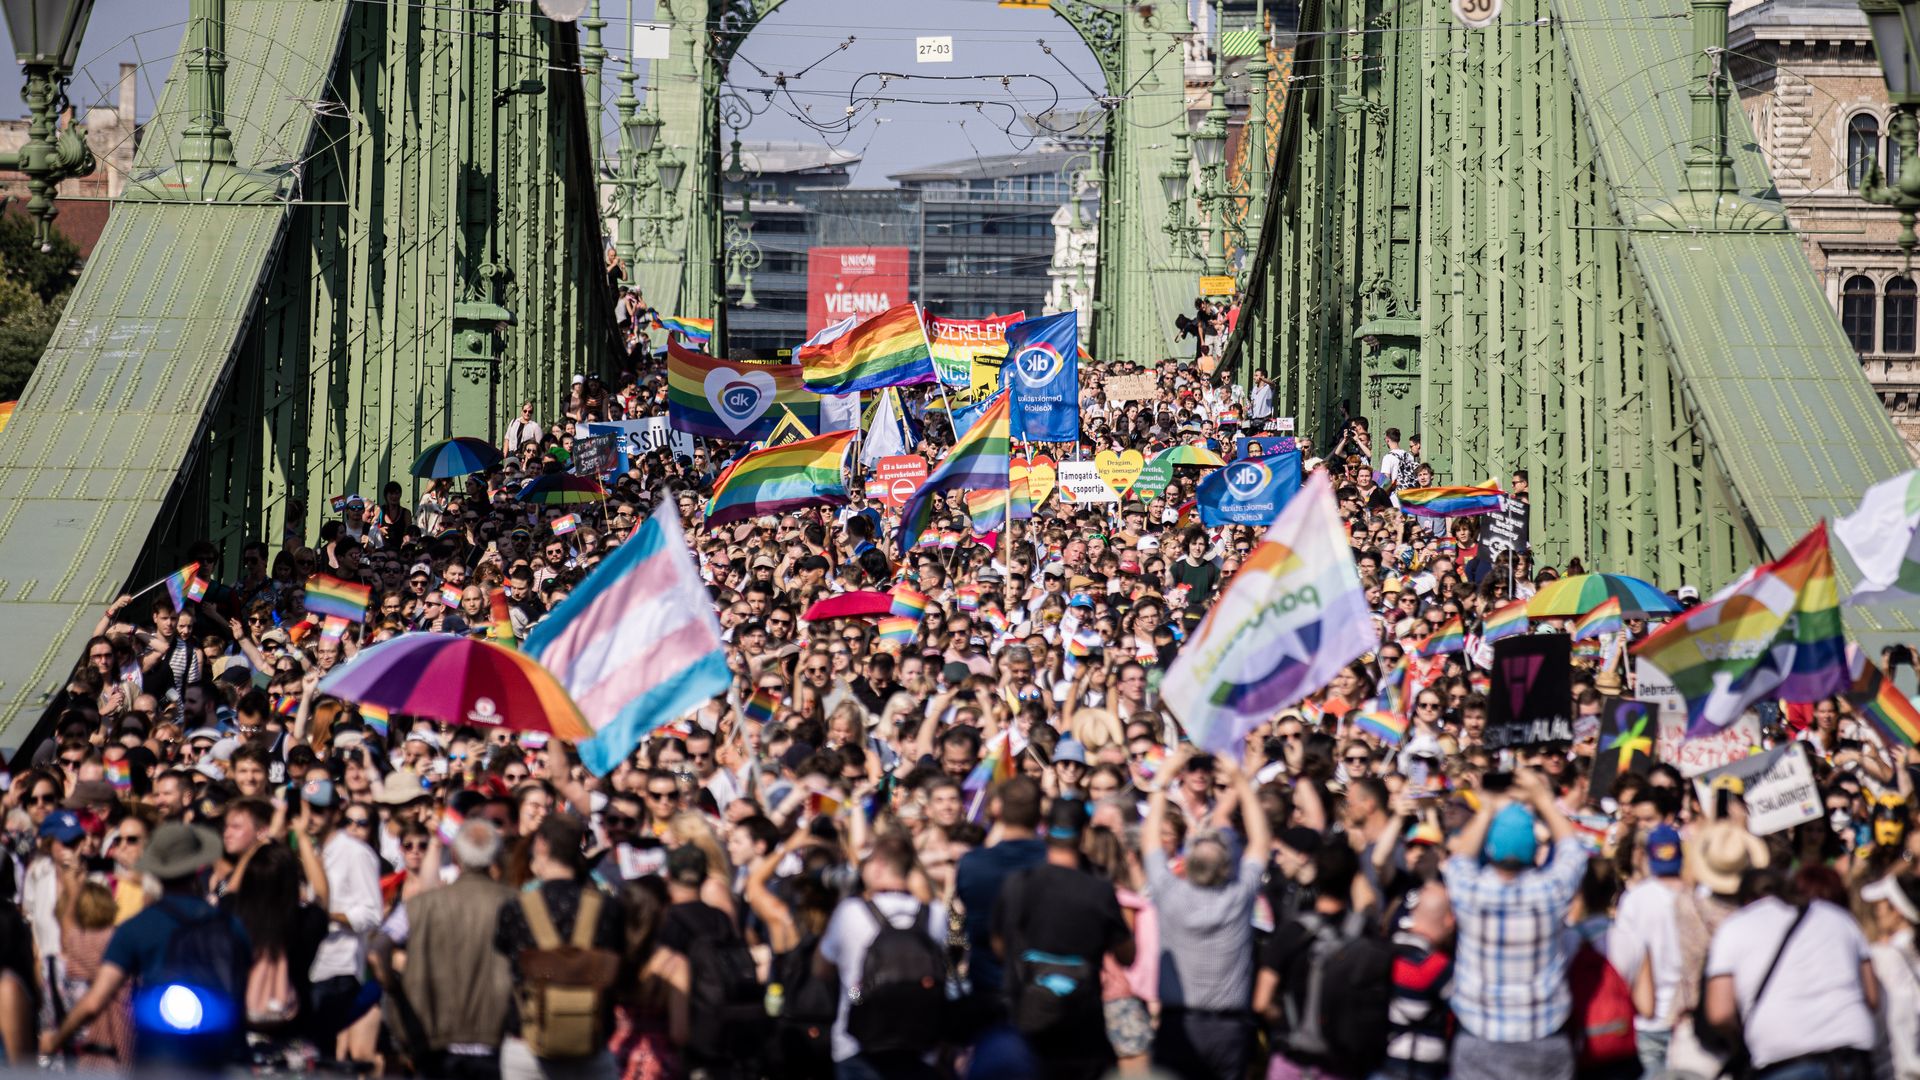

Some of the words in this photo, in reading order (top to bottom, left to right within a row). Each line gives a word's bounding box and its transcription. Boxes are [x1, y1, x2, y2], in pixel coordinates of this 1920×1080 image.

[1463, 0, 1491, 13] 30
[919, 44, 950, 55] 27-03
[841, 254, 876, 267] UNION
[825, 292, 891, 313] VIENNA
[932, 321, 1007, 340] SZERELEM
[730, 393, 750, 407] dk
[624, 425, 683, 452] SSÜK!
[1060, 470, 1092, 481] Támogató
[1073, 484, 1104, 495] csoportja
